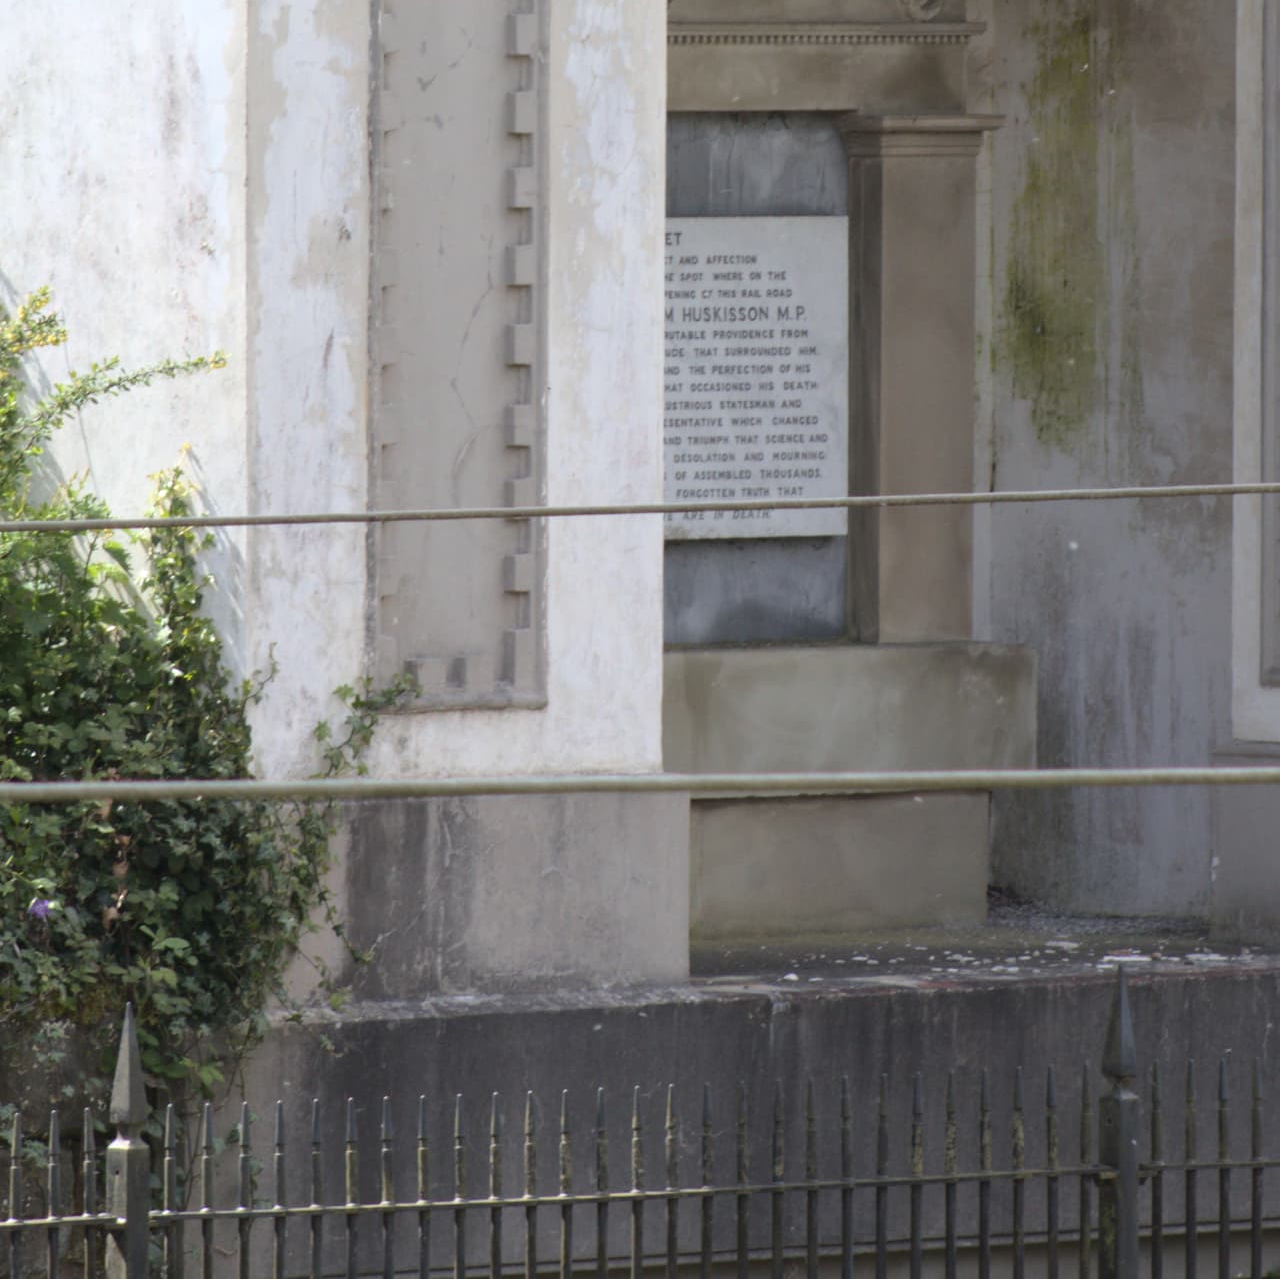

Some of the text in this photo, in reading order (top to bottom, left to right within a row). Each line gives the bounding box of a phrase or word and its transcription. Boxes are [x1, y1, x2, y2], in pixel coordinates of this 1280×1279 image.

[706, 255, 757, 265] AFFECTION
[680, 273, 703, 282] SPOT
[713, 272, 743, 281] WHERE
[749, 272, 762, 281] ON
[768, 271, 787, 280] THE
[718, 290, 736, 298] THIS
[742, 289, 762, 298] RAIL
[766, 289, 793, 298] ROAD
[682, 307, 769, 321] HUSKISSON
[713, 330, 774, 339] PROVIDENCE
[781, 330, 808, 338] FROM
[693, 348, 718, 357] THAT
[724, 347, 791, 356] SURROUNDED
[689, 366, 706, 375] THE
[712, 365, 774, 374] PERFECTION
[779, 364, 791, 373] OF
[795, 364, 811, 373] HIS
[691, 383, 752, 392] OCCASIONED
[759, 382, 774, 391] HIS
[720, 400, 775, 410] STATESMAN
[781, 399, 802, 409] AND
[731, 417, 762, 426] WHICH
[772, 416, 819, 426] CHANGED
[688, 435, 729, 445] TRIUMPH
[736, 435, 758, 444] THAT
[765, 434, 805, 443] SCIENCE
[809, 434, 828, 443] AND
[673, 452, 735, 463] DESOLATION
[744, 452, 764, 462] AND
[676, 471, 687, 481] OF
[694, 470, 752, 480] ASSEMBLED
[676, 487, 804, 498] FORGOTTEN TRUTH THAT
